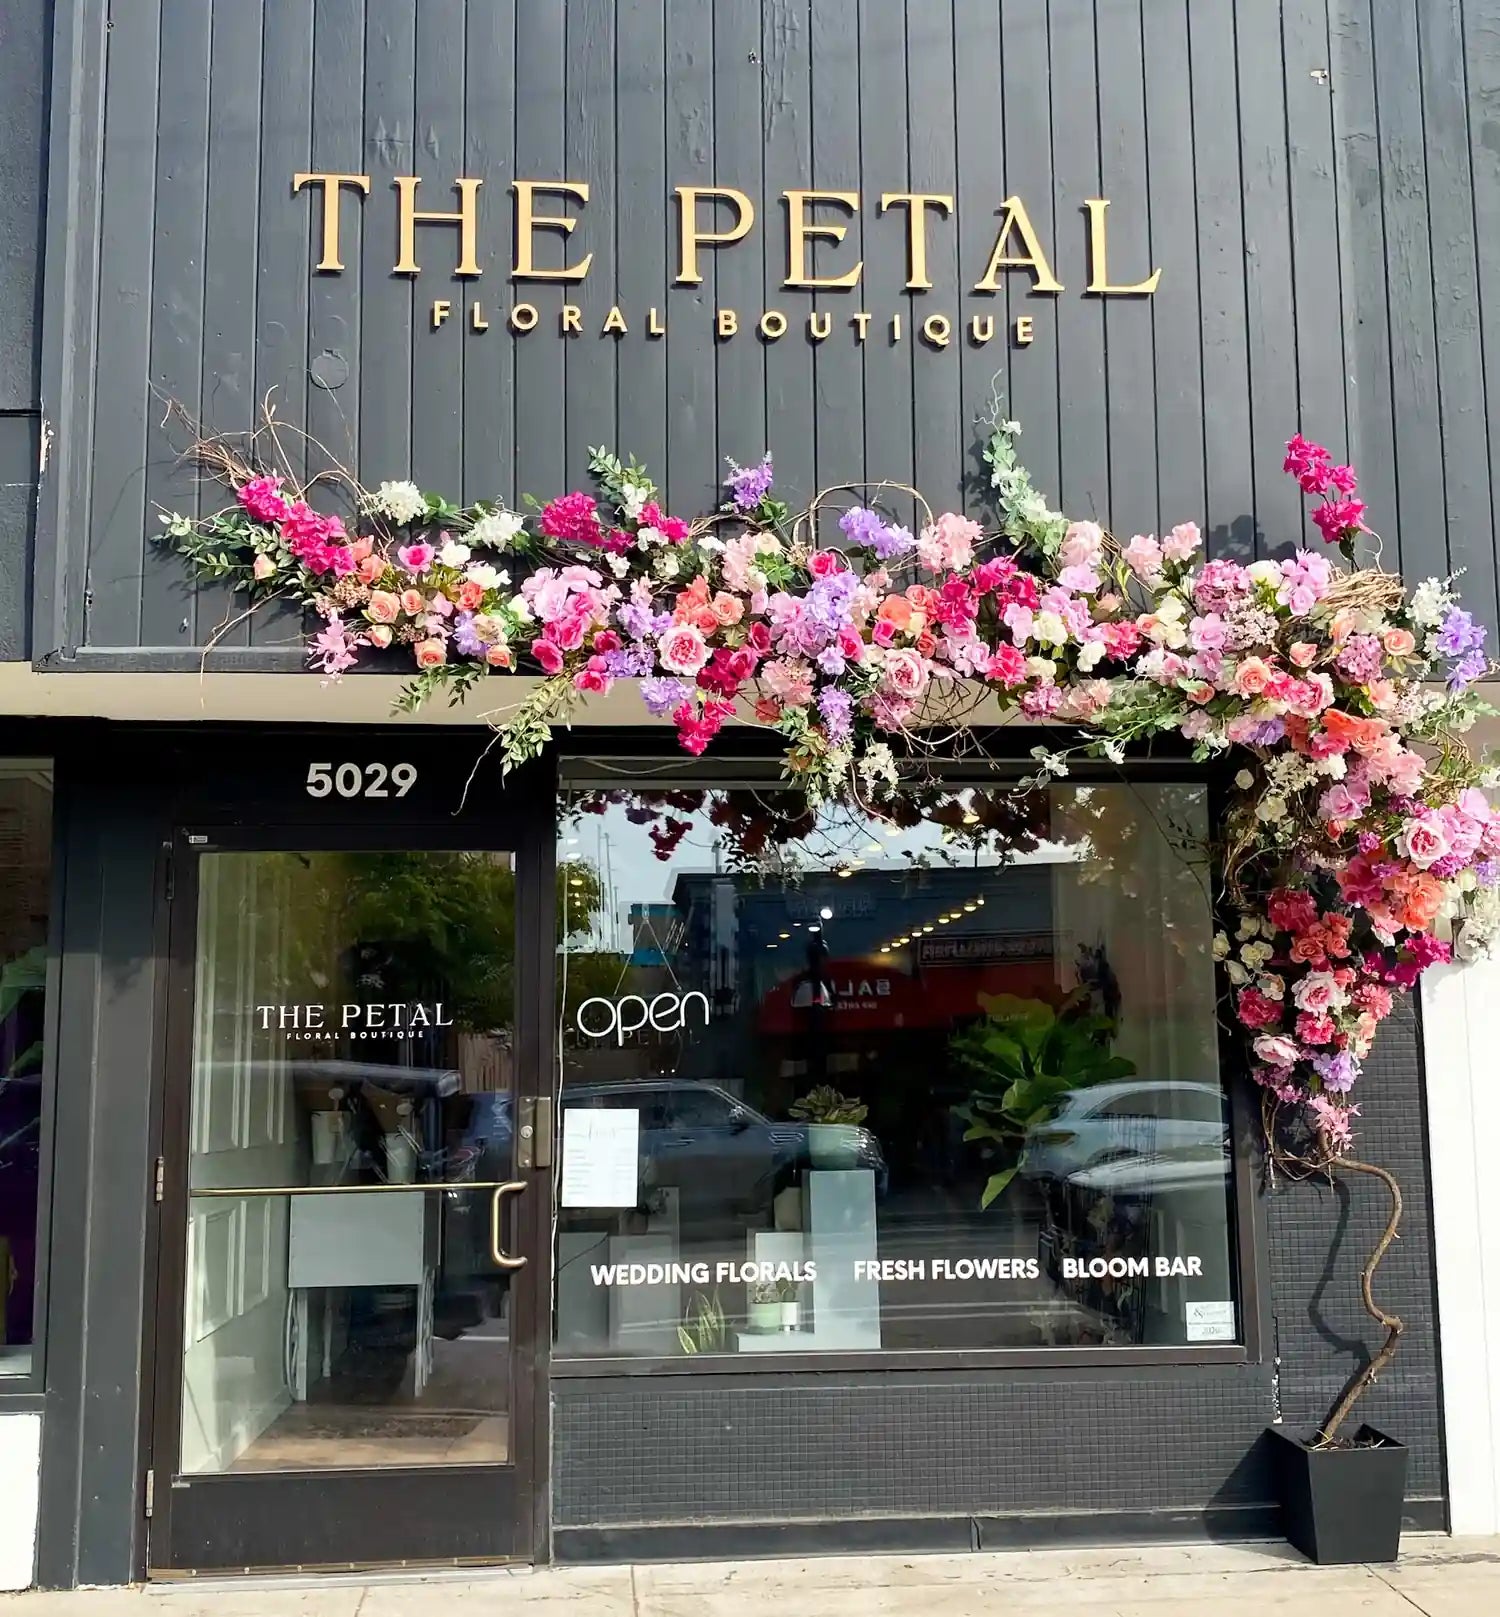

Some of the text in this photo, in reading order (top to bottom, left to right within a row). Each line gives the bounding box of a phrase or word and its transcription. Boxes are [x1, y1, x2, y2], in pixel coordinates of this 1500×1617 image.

[293, 172, 1163, 295] THE PETAL
[433, 300, 1034, 346] FLORAL BOUTIQUE
[306, 762, 418, 798] 5029
[256, 1003, 454, 1029] THE PETAL
[576, 991, 710, 1047] open
[286, 1030, 424, 1041] FLORAL BOUTIQUE
[590, 1260, 817, 1286] WEDDING FLORALS
[853, 1258, 1040, 1282] FRESH FLOWERS
[1063, 1256, 1204, 1278] BLOOM BAR
